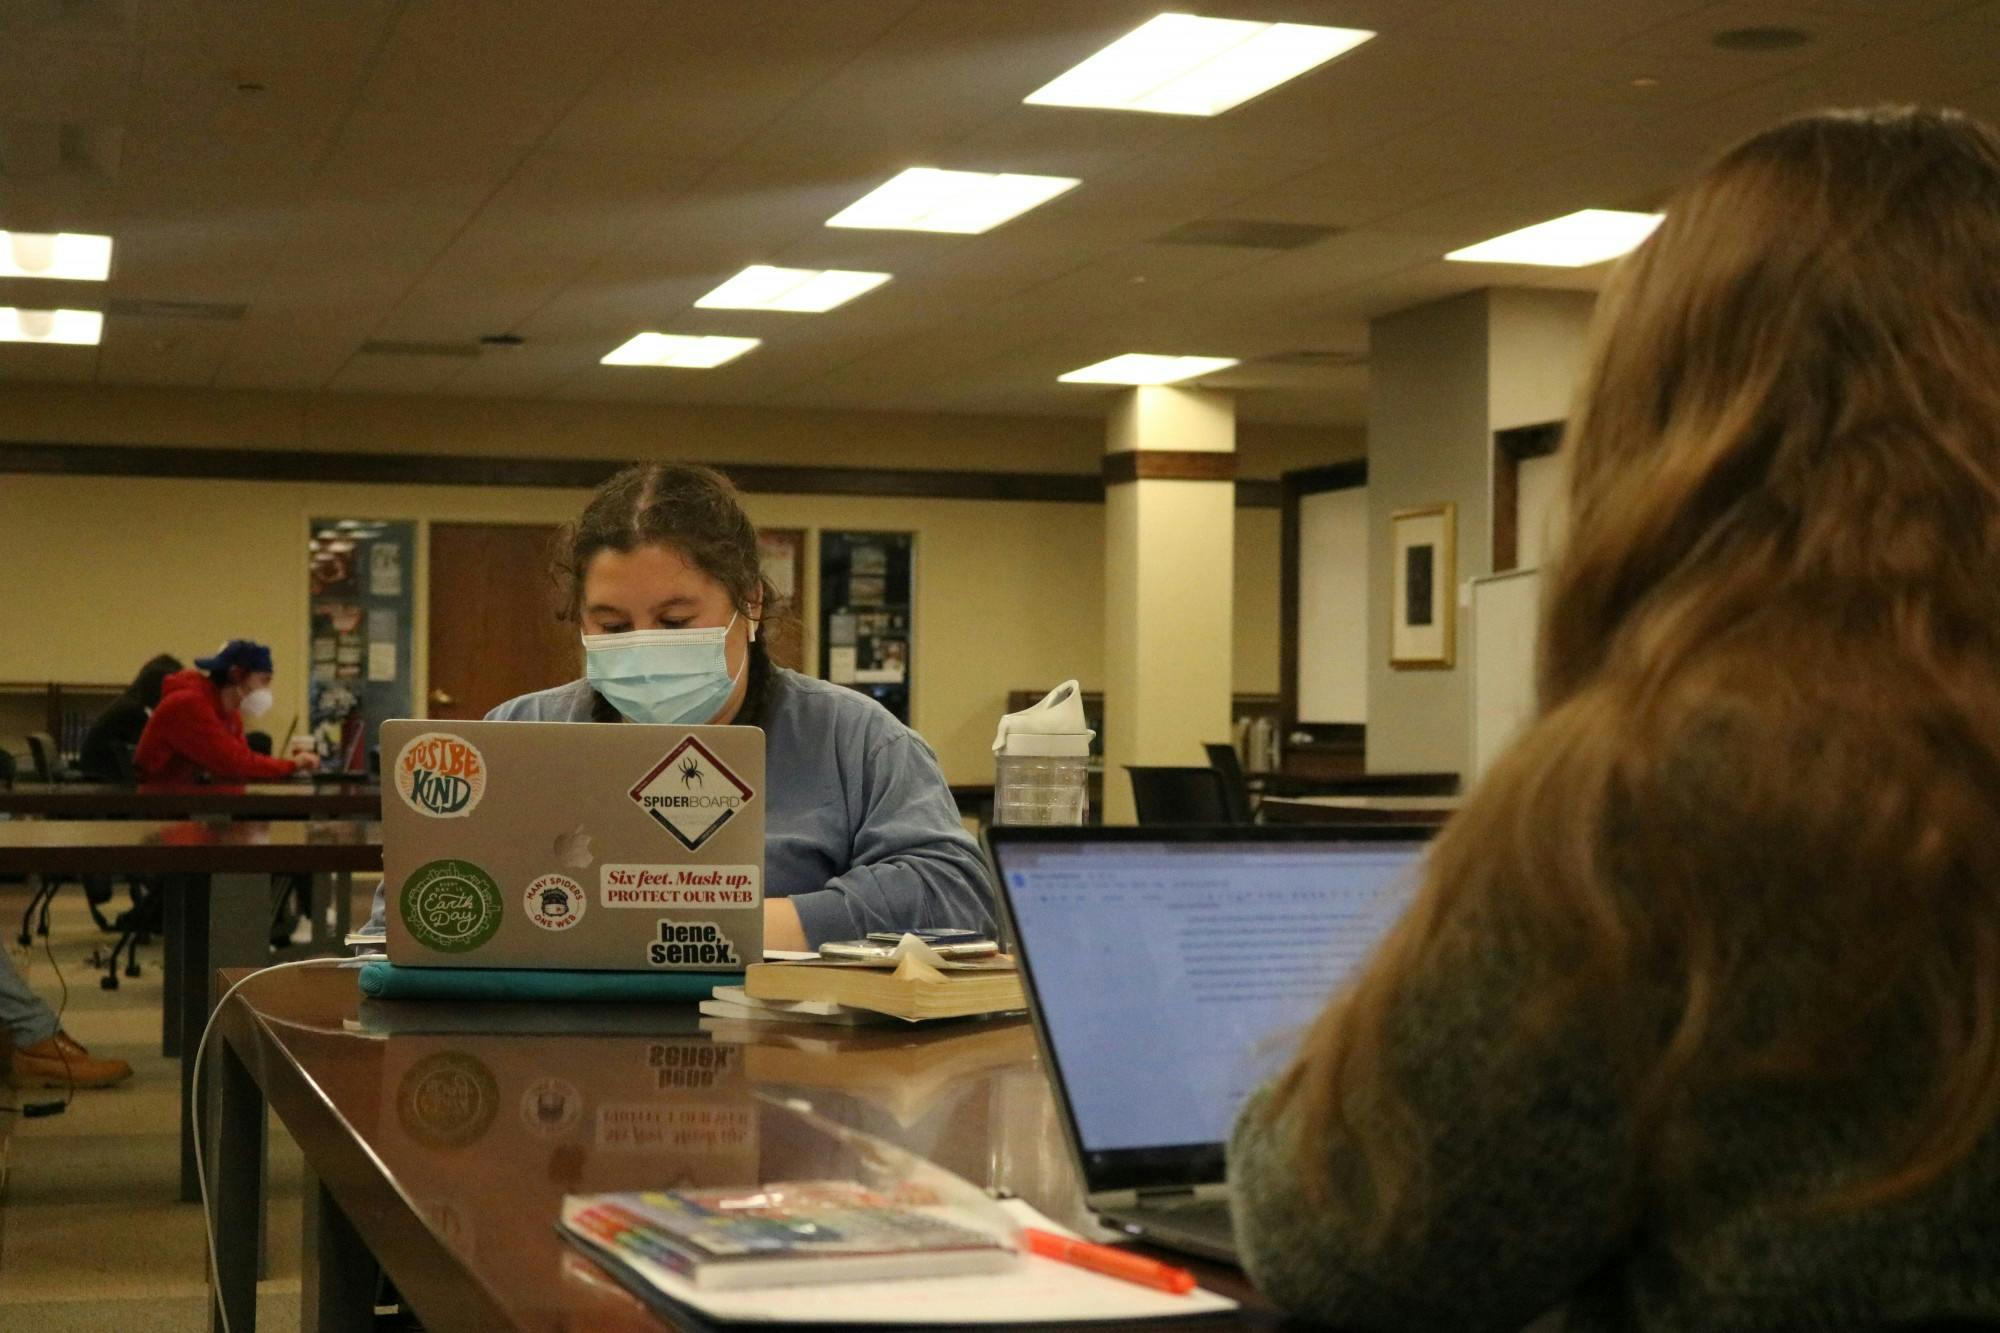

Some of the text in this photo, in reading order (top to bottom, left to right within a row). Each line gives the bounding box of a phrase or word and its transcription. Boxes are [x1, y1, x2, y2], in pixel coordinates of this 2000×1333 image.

[404, 738, 480, 777] JUST BE
[410, 769, 471, 814] KIND
[643, 796, 740, 808] SPIDERBOARD
[527, 877, 583, 901] MANY SPIDERS
[608, 870, 752, 889] Six feet. Mask up.
[424, 892, 474, 912] Earth
[608, 890, 753, 903] PROTECT OUR WEB
[430, 910, 477, 933] Day
[534, 914, 576, 928] ONE WEB
[661, 923, 722, 944] bene,
[651, 943, 737, 964] senex.
